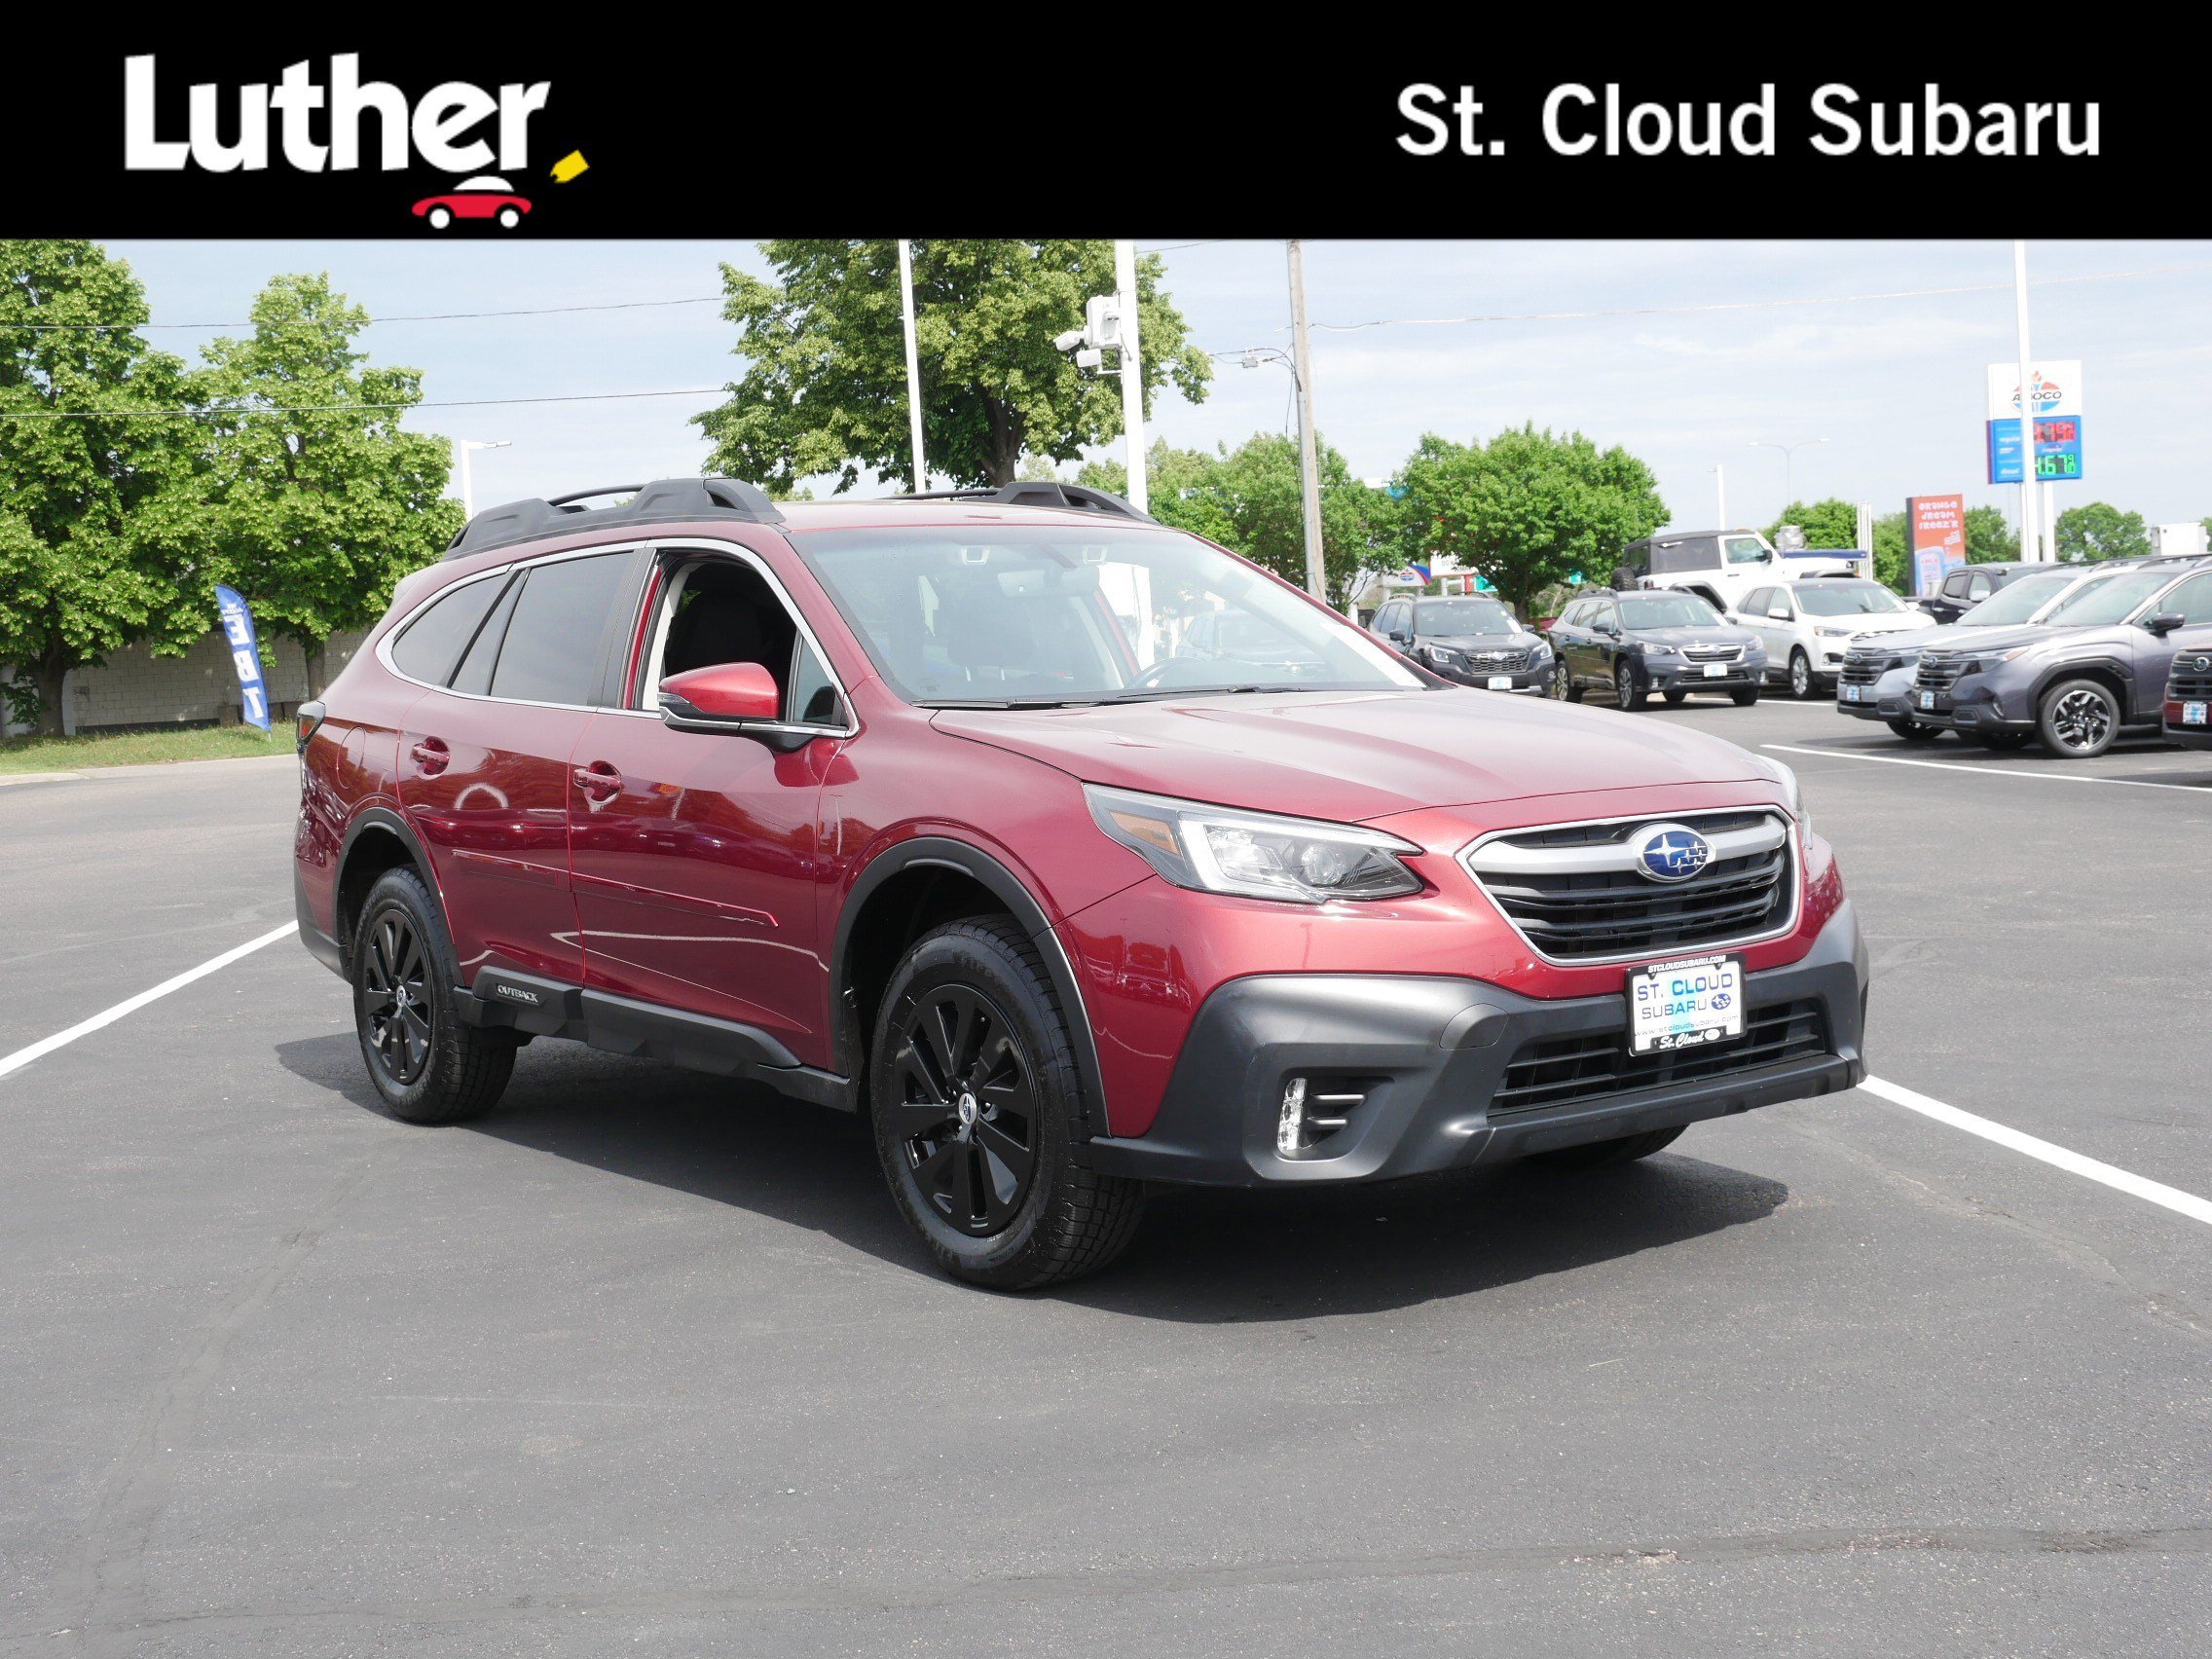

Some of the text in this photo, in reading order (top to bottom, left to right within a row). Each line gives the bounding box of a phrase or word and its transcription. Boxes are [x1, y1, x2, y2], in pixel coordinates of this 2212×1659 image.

[2011, 391, 2062, 401] AOCO
[1647, 955, 1726, 973] STCLOUDSUBARU.COM
[498, 984, 538, 1003] OUTBACK
[1638, 973, 1733, 1001] ST. CLOUD
[1641, 999, 1708, 1019] SUBARU
[1659, 1031, 1705, 1050] St. Cloud
